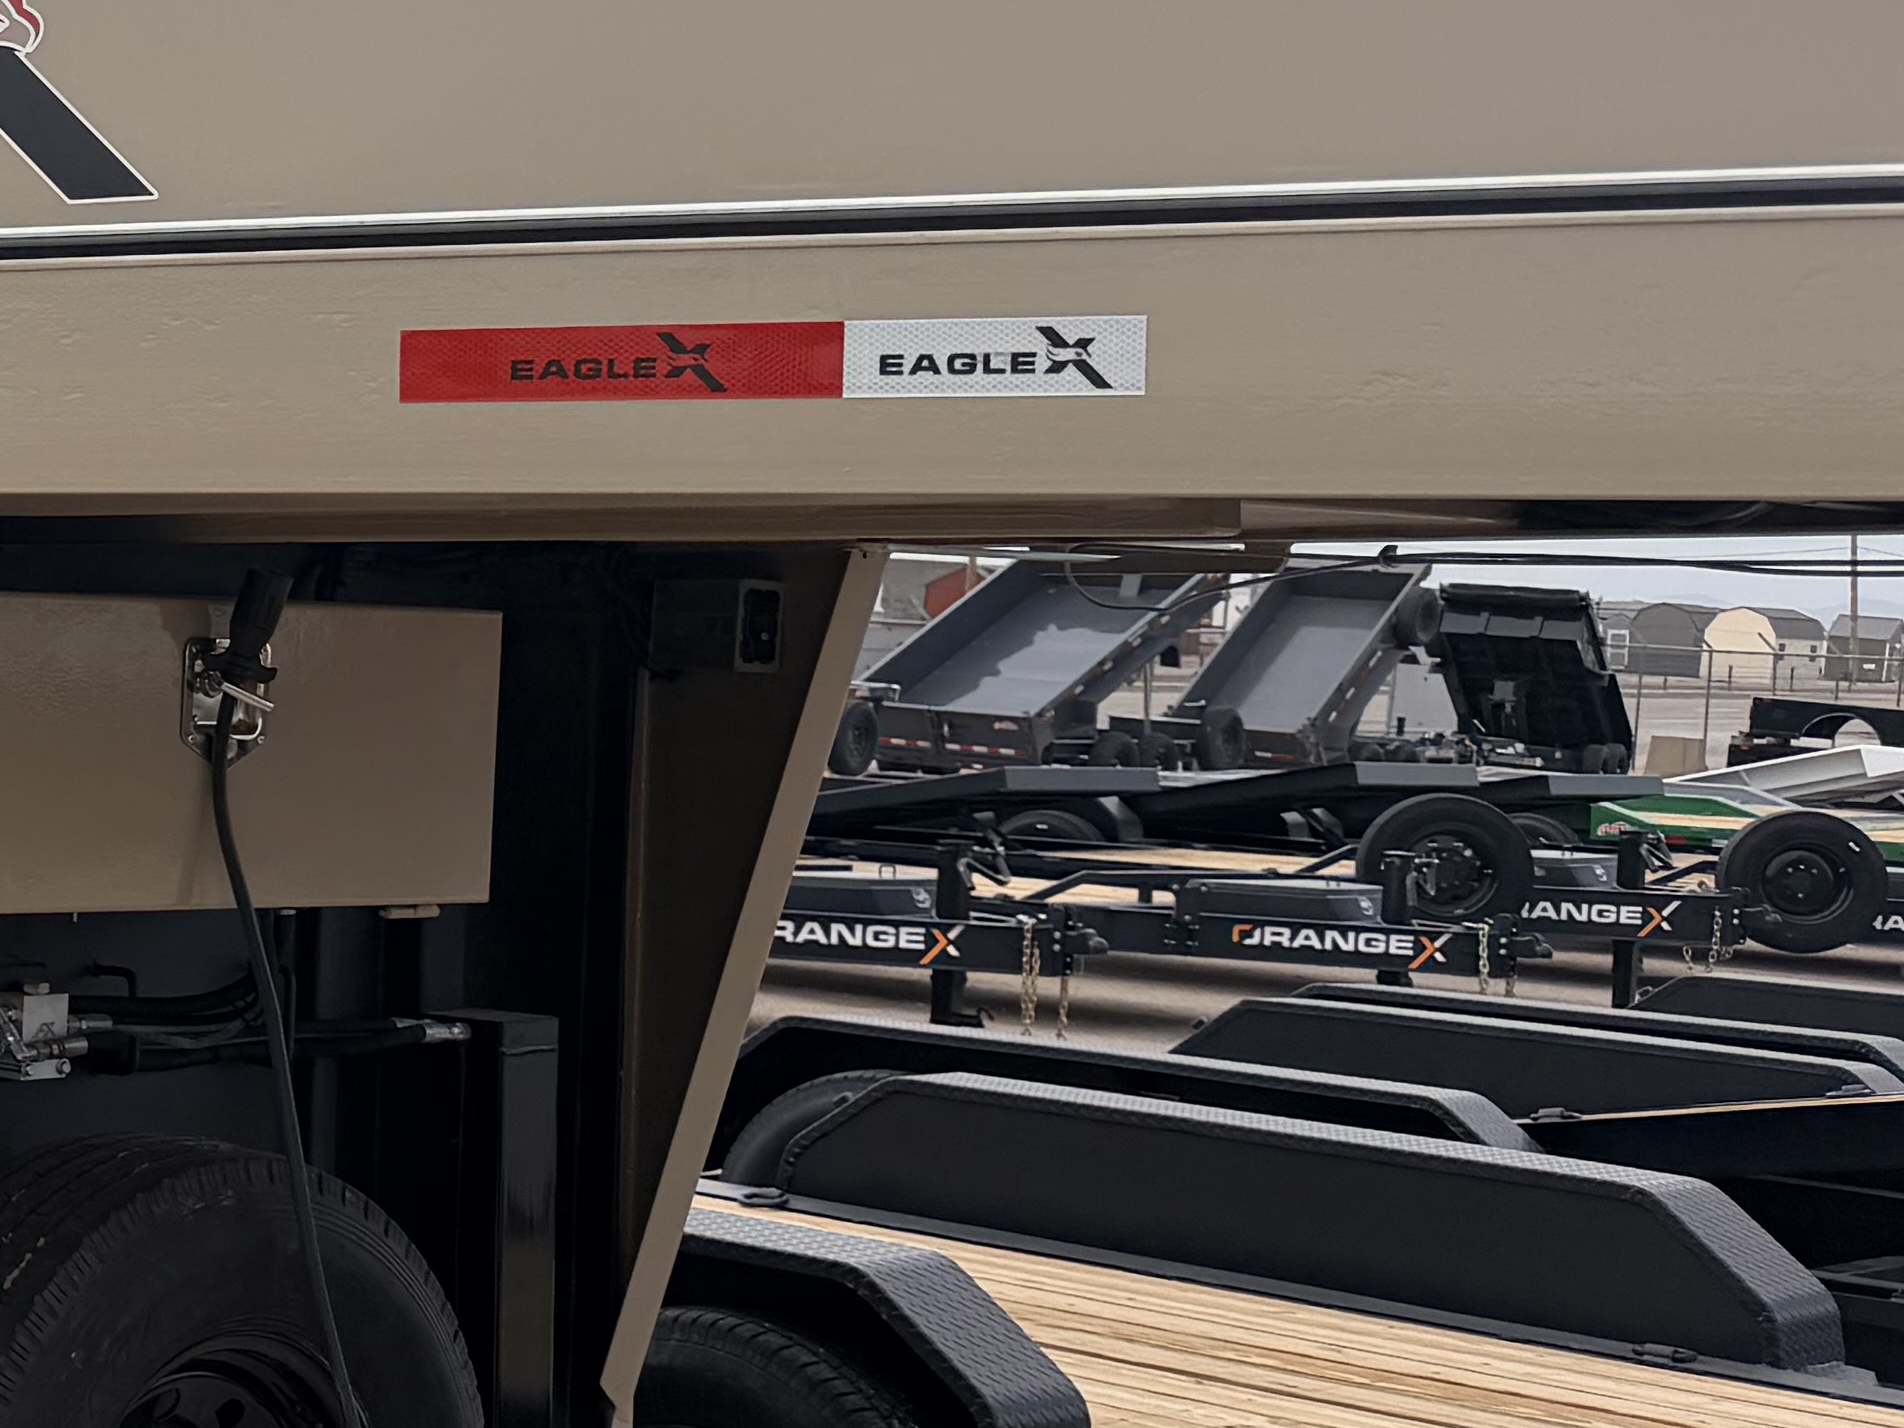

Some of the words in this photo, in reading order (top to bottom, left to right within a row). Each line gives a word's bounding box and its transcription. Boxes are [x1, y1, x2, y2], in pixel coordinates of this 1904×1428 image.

[509, 332, 728, 392] EAGLEX
[878, 326, 1114, 389] EAGLEX
[1521, 900, 1682, 937] ANGEX
[773, 920, 965, 965] RANGEX
[1232, 924, 1454, 970] ORANGEX
